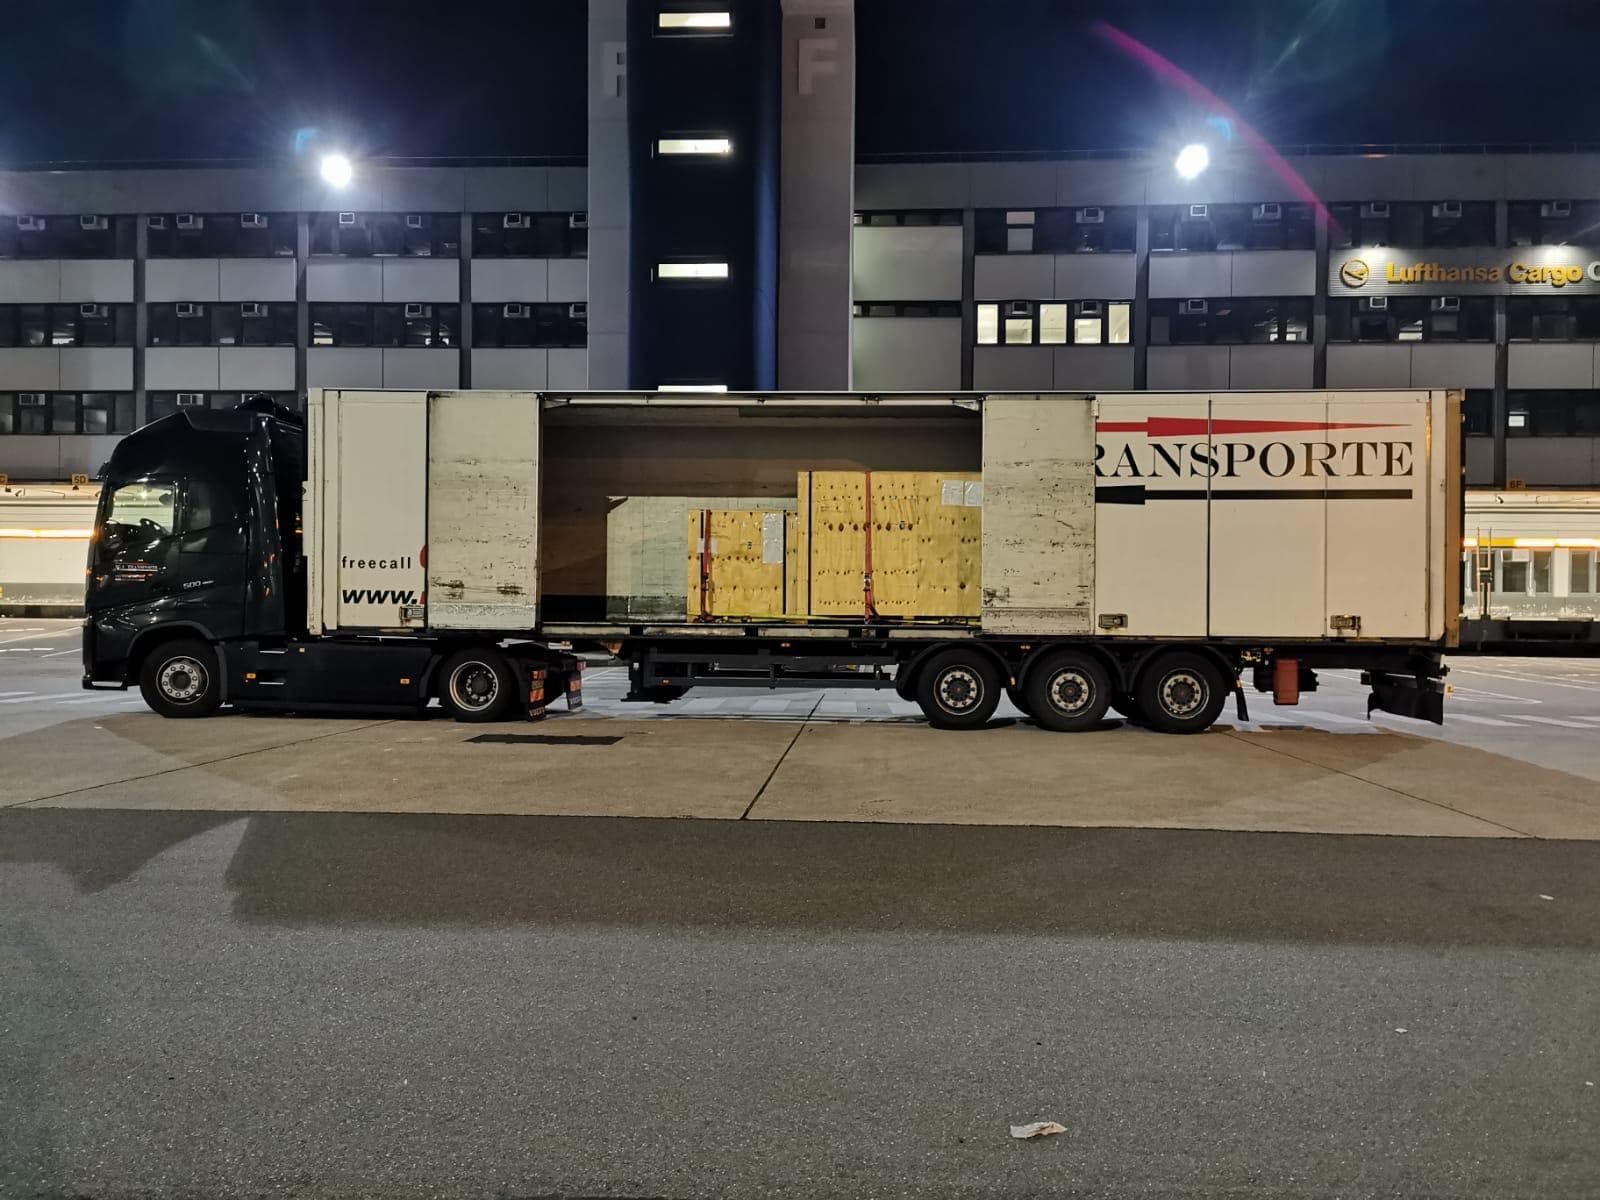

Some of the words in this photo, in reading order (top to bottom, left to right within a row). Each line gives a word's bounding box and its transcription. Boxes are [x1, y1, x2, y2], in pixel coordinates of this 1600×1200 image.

[798, 38, 839, 95] F
[1387, 262, 1501, 283] Lufthansa
[1509, 262, 1583, 287] Cargo
[342, 555, 411, 569] freecall
